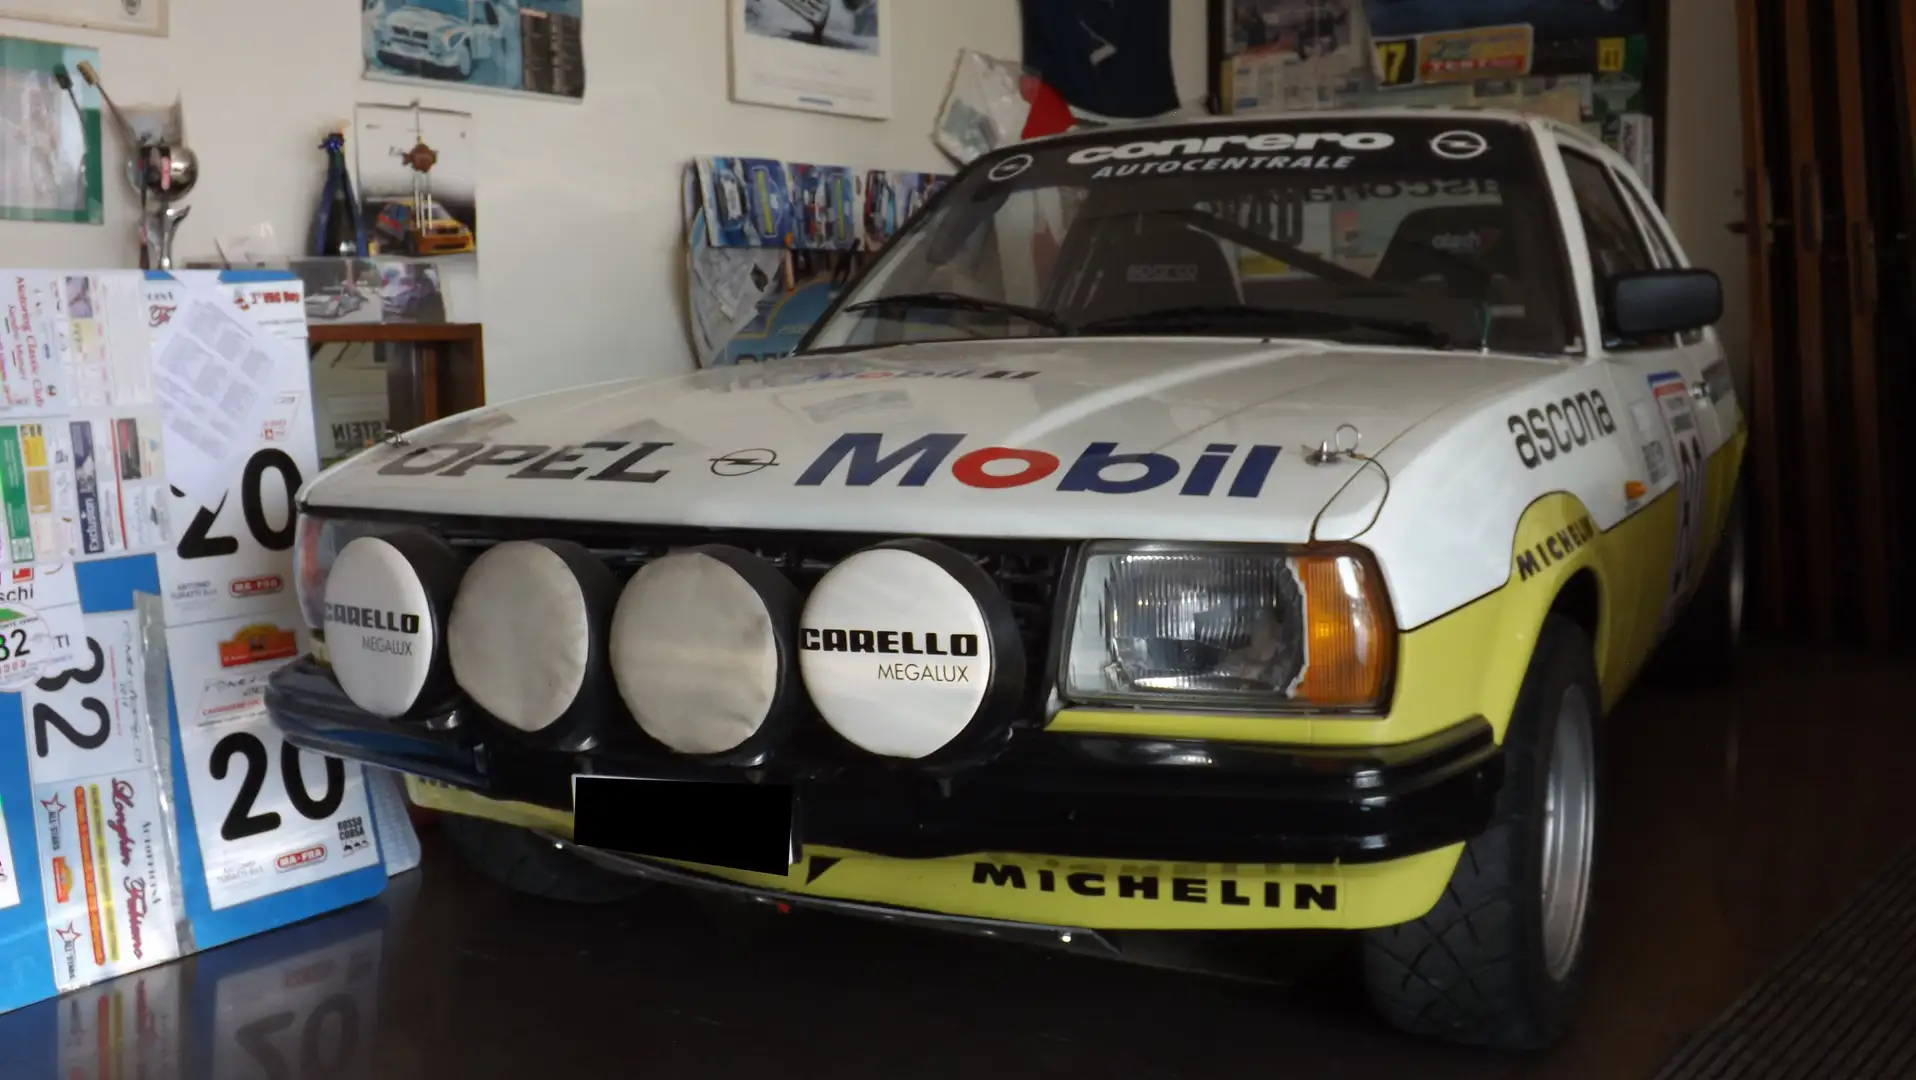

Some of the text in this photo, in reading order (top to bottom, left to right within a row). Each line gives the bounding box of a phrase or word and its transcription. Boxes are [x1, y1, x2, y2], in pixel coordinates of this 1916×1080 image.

[1067, 131, 1395, 164] conrero
[1091, 156, 1355, 179] AUTOCENTRALE
[1507, 389, 1617, 470] ascona
[377, 441, 675, 484] OPEL
[793, 433, 1284, 498] Mobil
[1515, 514, 1595, 583] MICHELIN
[324, 602, 420, 635] CARELLO
[362, 636, 413, 657] MEGALUX
[801, 628, 978, 657] CARELLO
[877, 663, 970, 683] MEGALUX
[209, 731, 346, 841] 20
